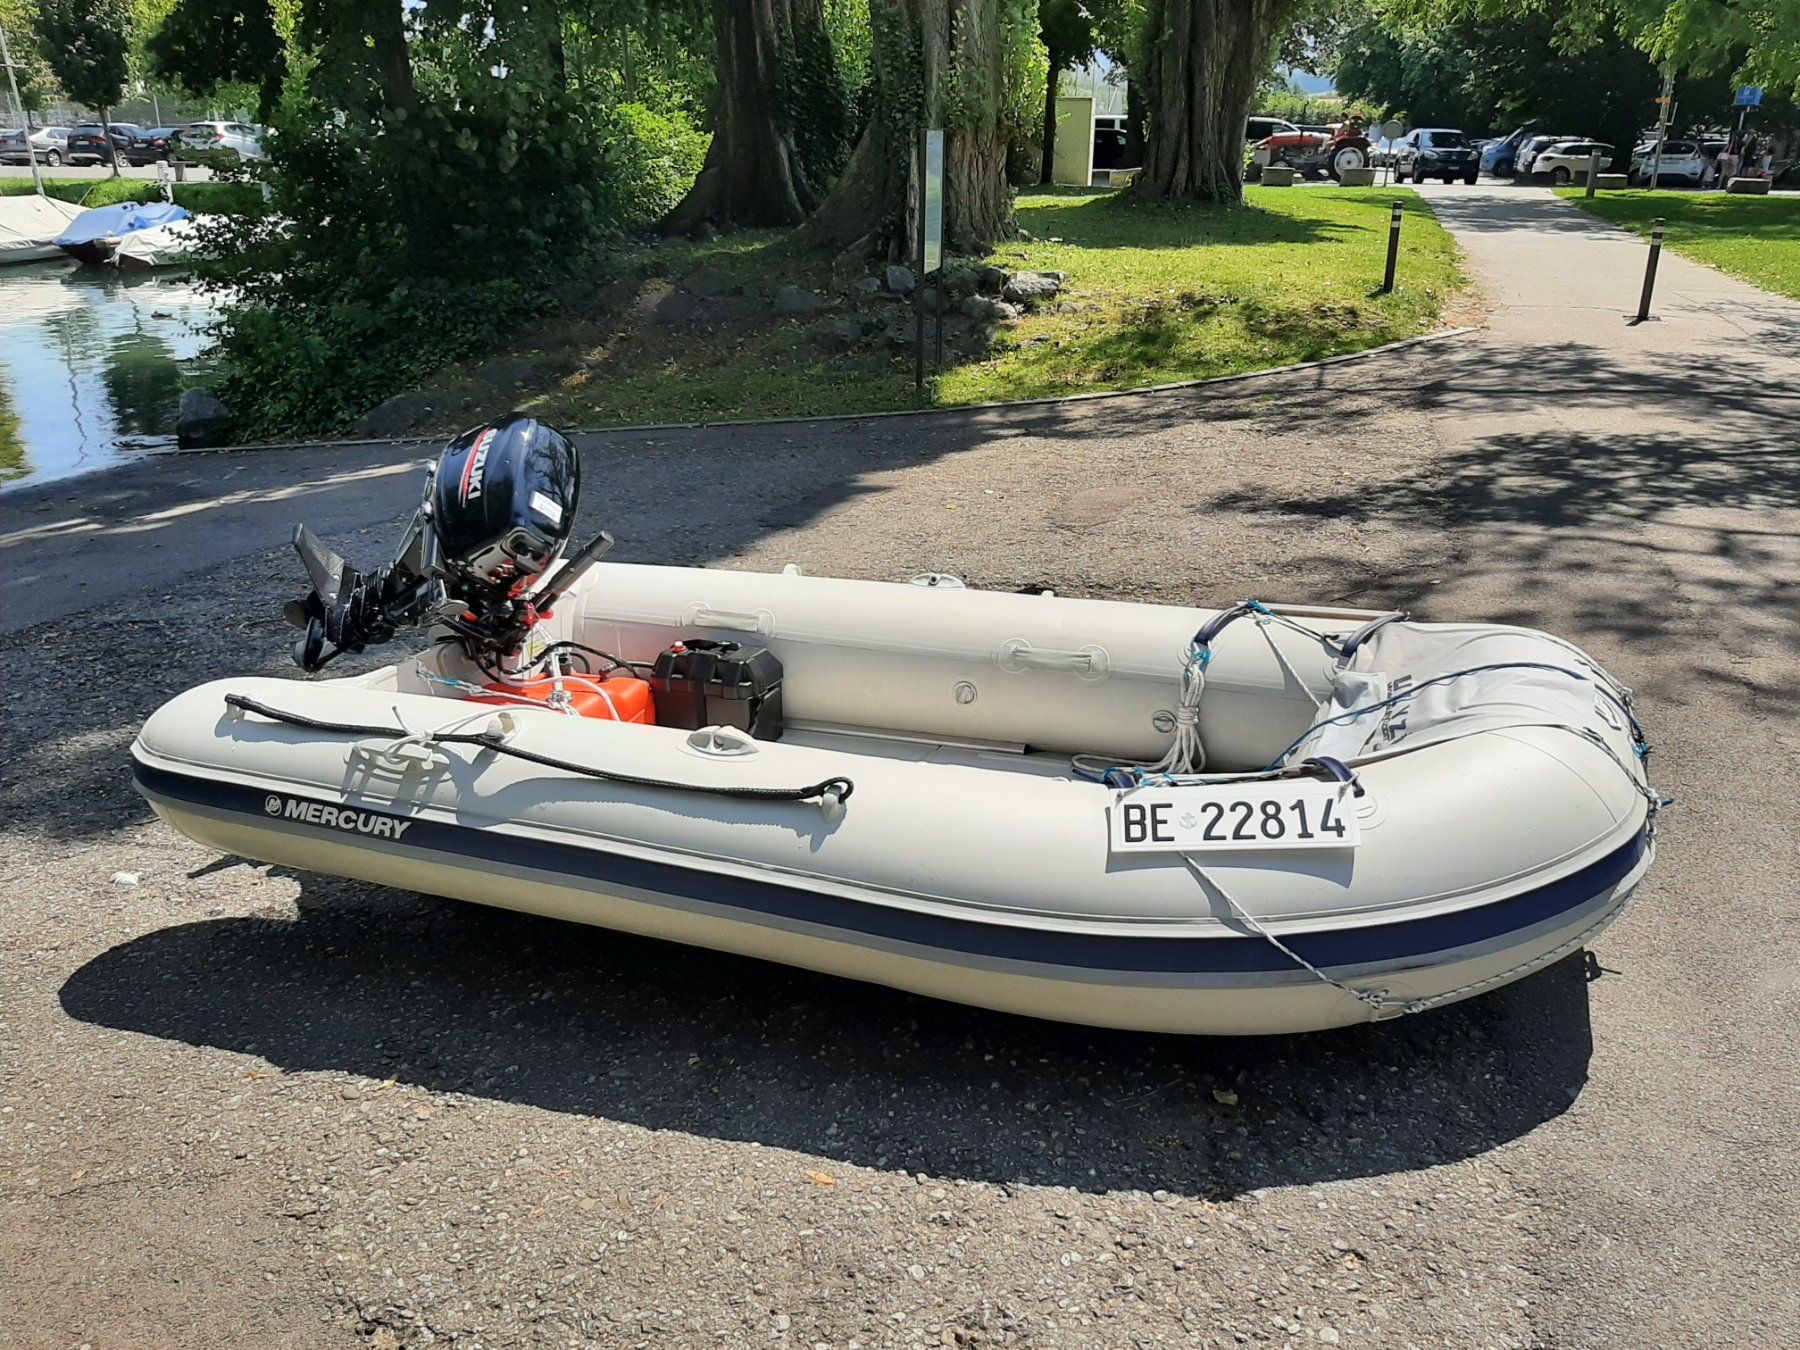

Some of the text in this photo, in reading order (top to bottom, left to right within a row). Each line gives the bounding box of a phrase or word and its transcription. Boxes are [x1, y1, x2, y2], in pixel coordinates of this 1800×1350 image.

[468, 428, 498, 500] SUZUKI
[284, 799, 412, 839] MERCURY
[1123, 798, 1346, 843] BE 22814
